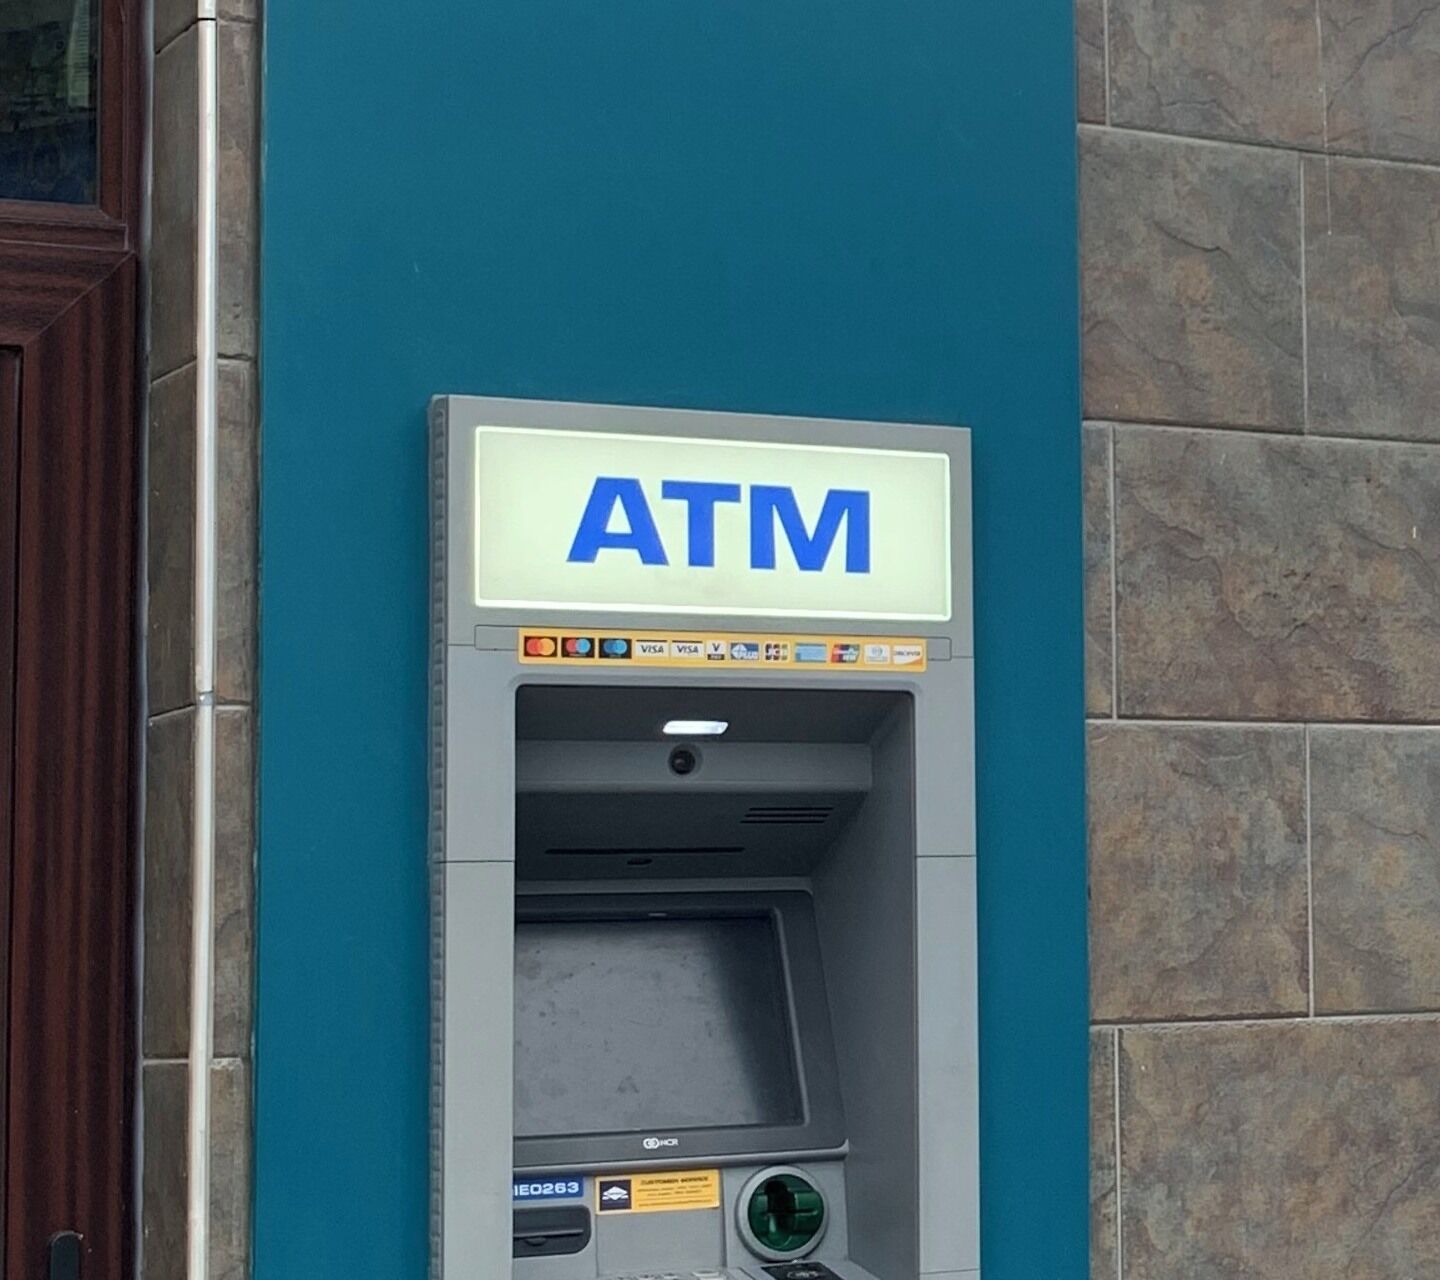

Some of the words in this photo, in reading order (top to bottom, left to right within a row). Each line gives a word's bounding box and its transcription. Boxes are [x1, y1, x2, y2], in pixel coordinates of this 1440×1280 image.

[566, 476, 870, 574] ATM
[640, 644, 664, 654] VISA
[676, 645, 699, 655] VISA
